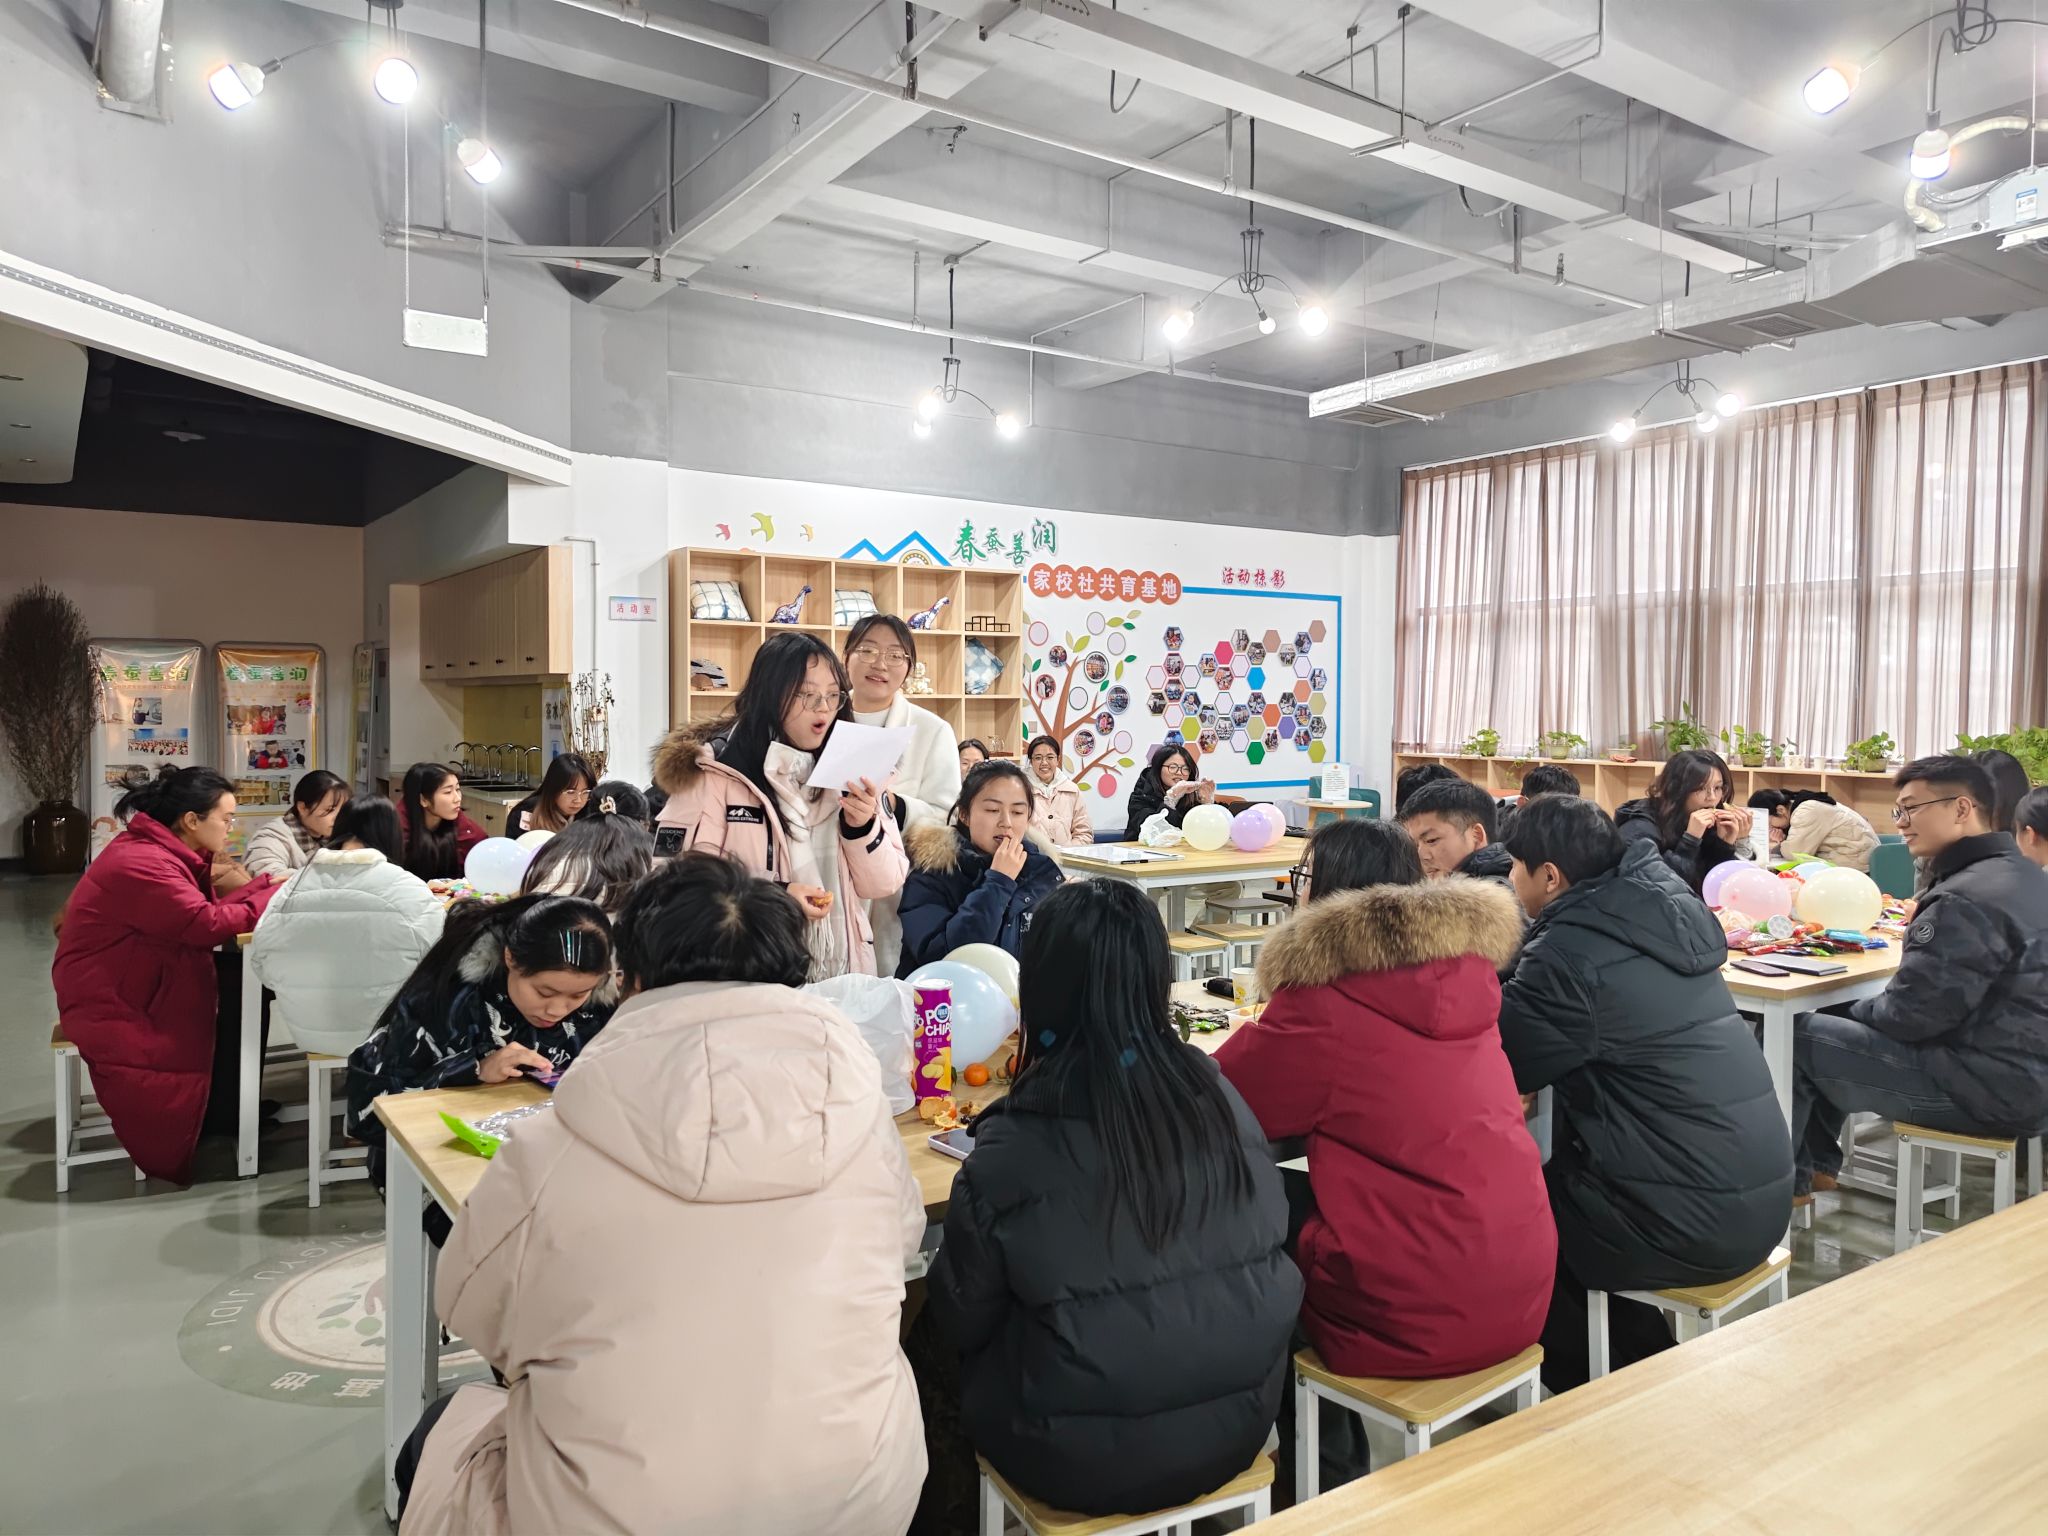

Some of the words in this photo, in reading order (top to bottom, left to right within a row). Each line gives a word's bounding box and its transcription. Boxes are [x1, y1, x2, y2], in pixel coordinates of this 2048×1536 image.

[952, 519, 1057, 565] 春蚕善润
[1032, 569, 1178, 600] 家校社共育基地
[1222, 568, 1286, 588] 活动掠影
[616, 603, 651, 615] 活动室
[206, 1288, 254, 1327] JIDI
